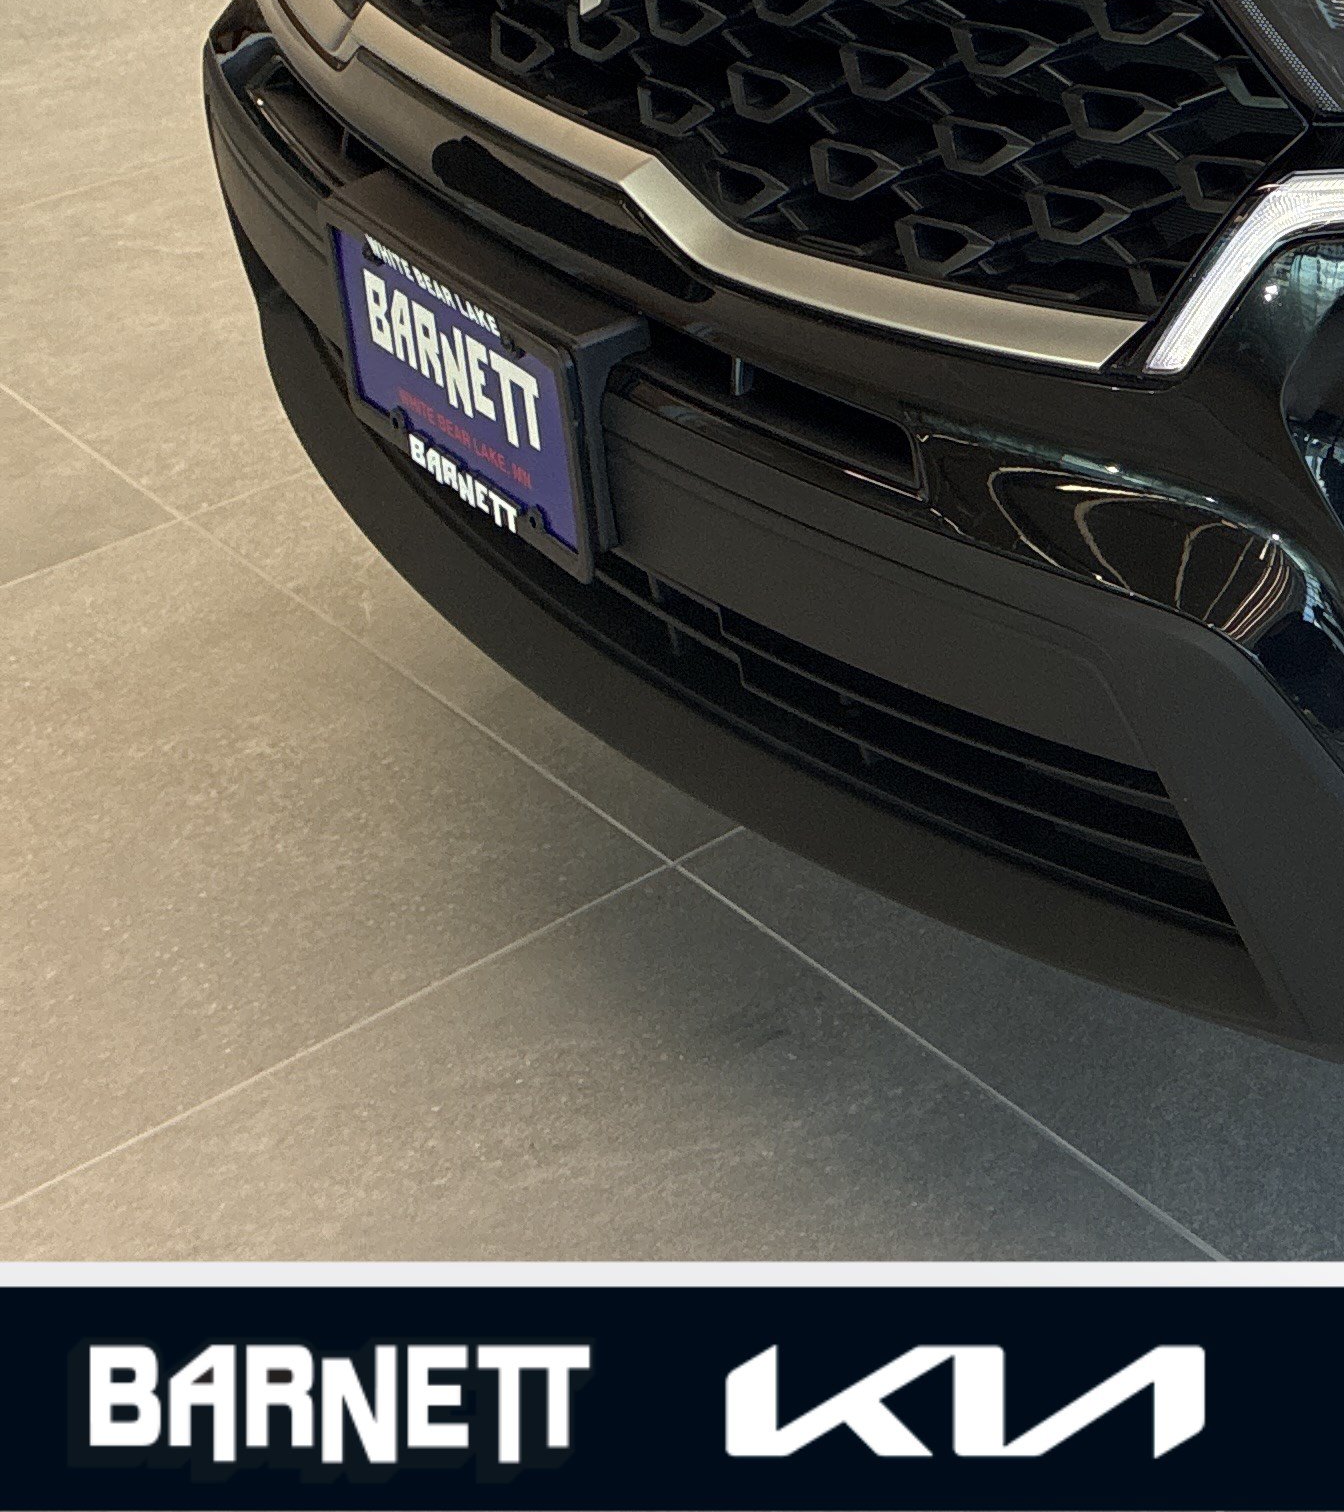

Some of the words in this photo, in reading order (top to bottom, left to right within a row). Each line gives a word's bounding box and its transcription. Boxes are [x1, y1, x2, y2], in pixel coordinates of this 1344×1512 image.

[411, 265, 457, 311] BEAR
[453, 293, 501, 338] LAKE
[362, 267, 541, 452] BARNETT
[408, 433, 518, 534] BARNETT
